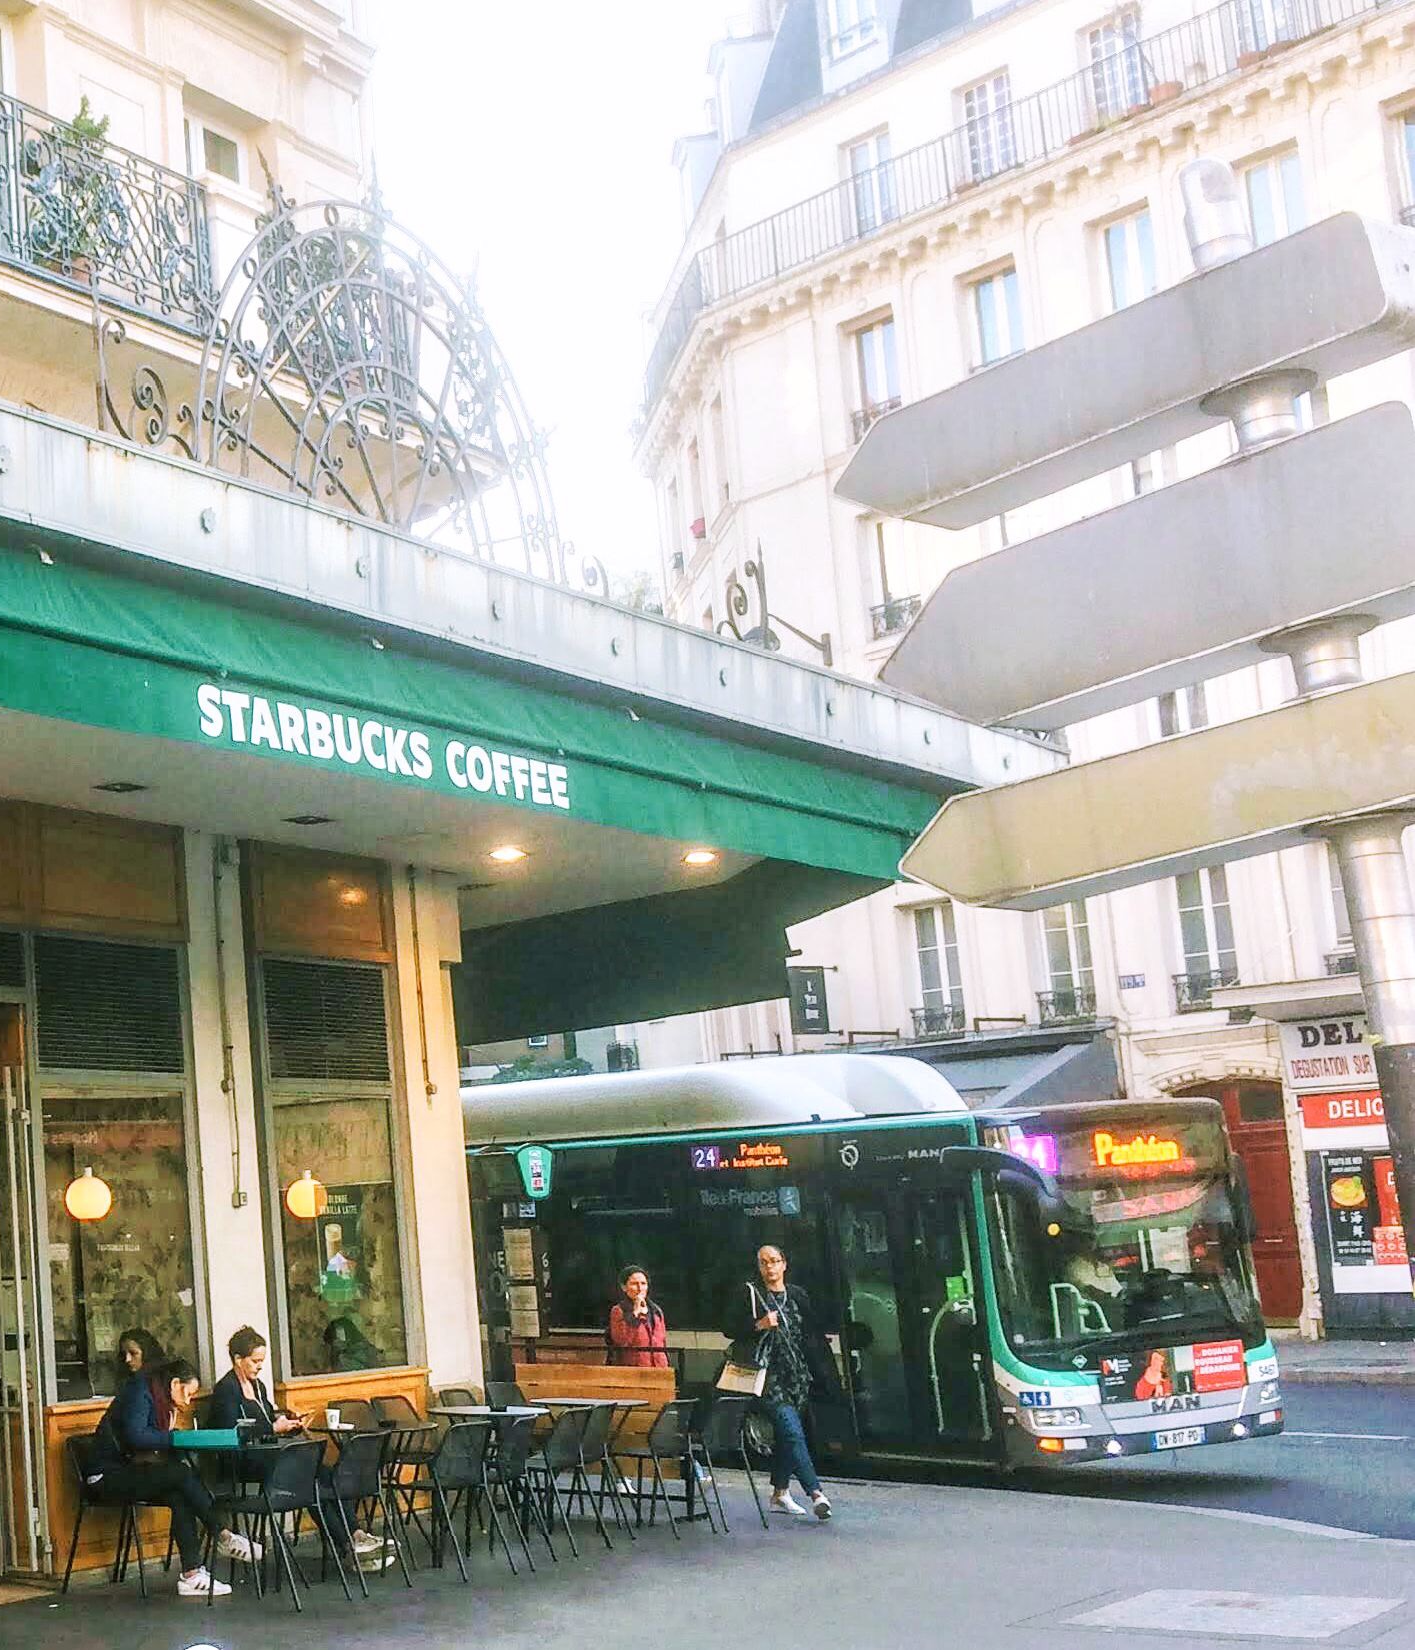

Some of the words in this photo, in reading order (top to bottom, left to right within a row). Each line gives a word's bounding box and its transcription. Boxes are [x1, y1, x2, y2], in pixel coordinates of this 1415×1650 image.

[197, 683, 433, 780] STARBUCKS
[444, 739, 571, 810] COFFEE
[1290, 1056, 1350, 1079] DEGUSTATION
[694, 1148, 716, 1168] 24
[1151, 1396, 1201, 1413] MAN
